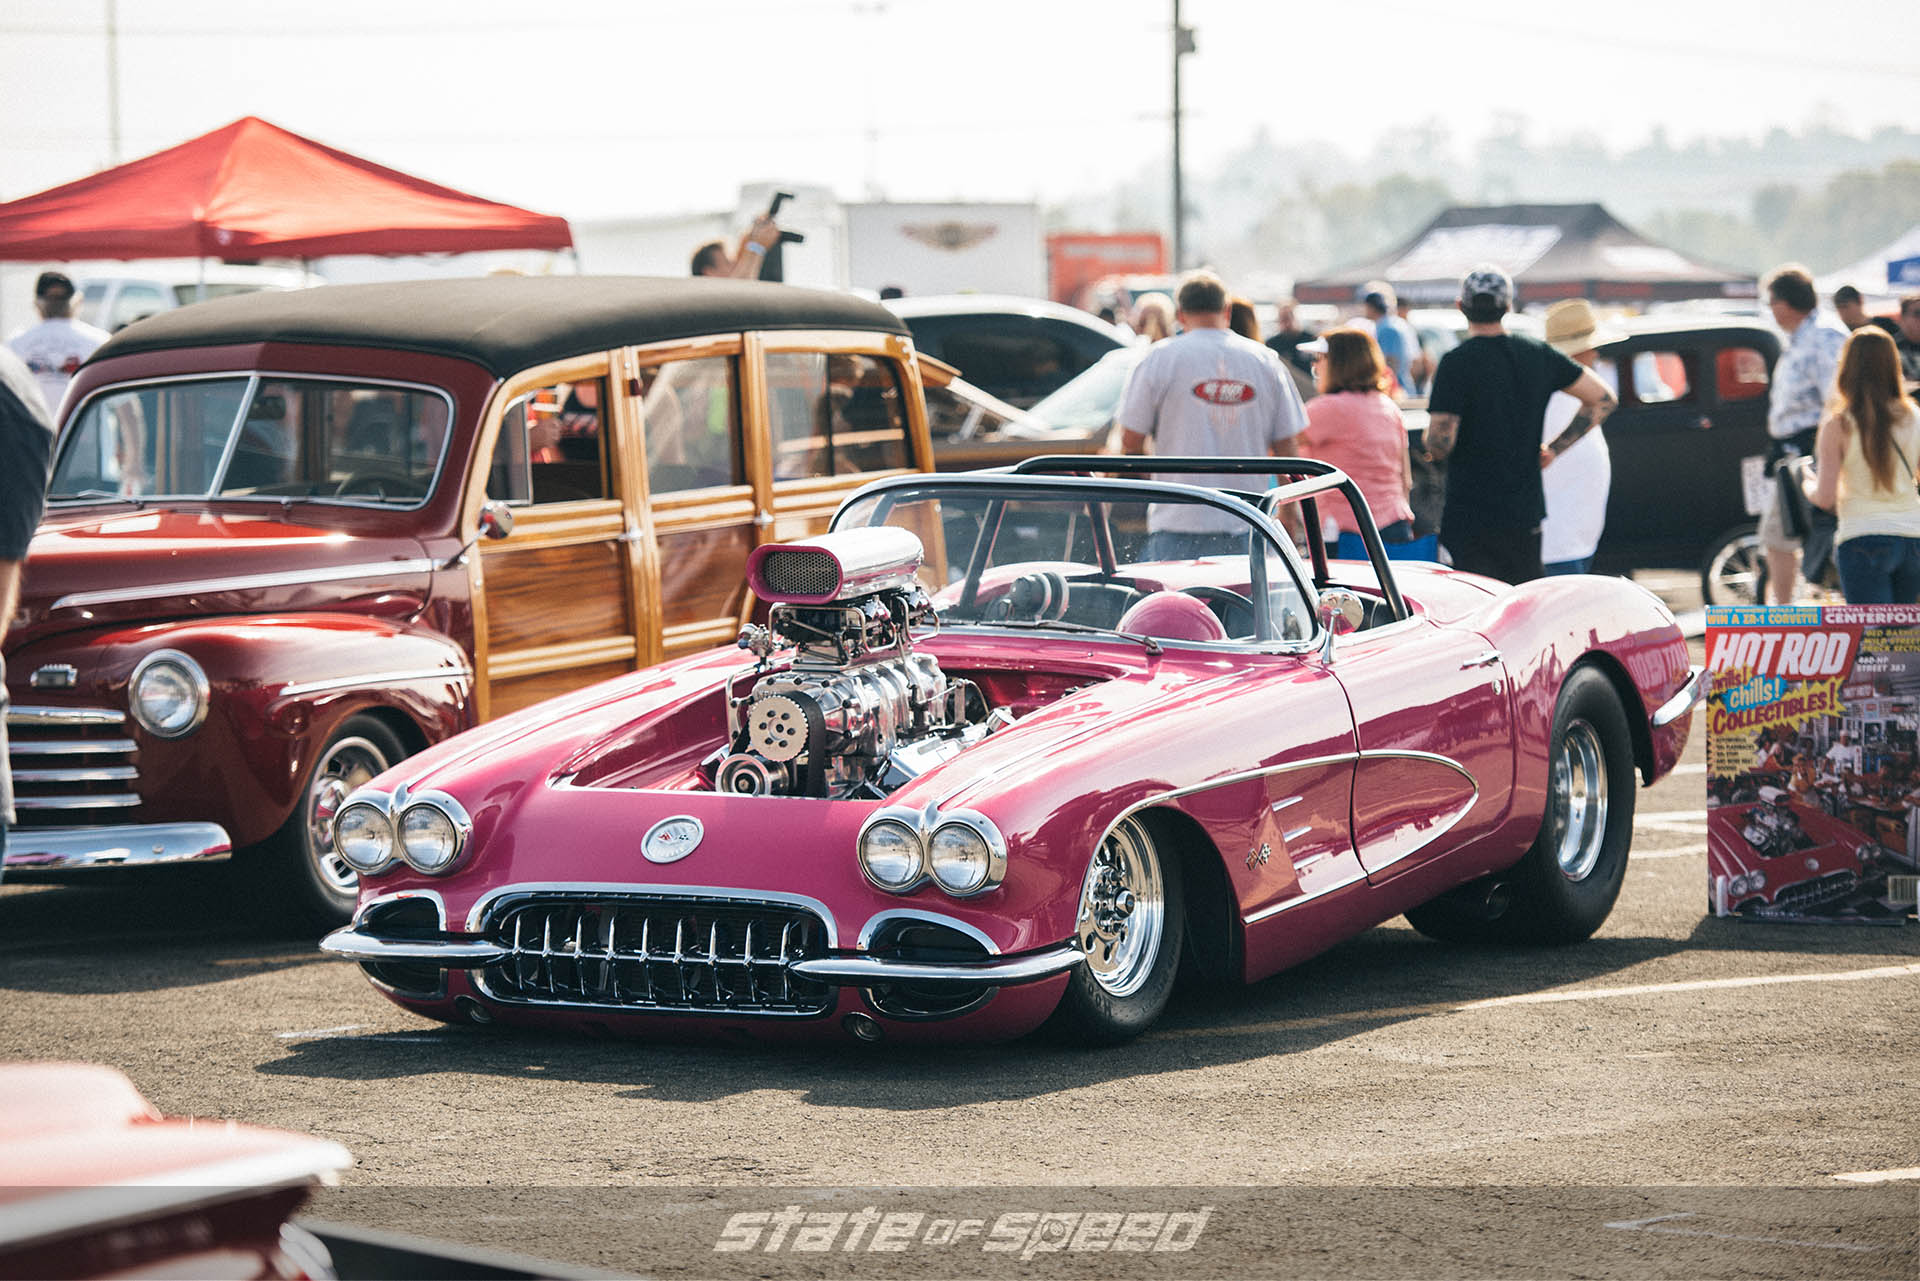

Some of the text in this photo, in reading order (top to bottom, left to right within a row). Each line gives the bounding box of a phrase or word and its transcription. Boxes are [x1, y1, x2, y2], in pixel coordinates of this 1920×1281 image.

[1707, 614, 1728, 624] WIN
[1731, 614, 1740, 624] A
[1768, 614, 1818, 624] CORVETTE
[1707, 632, 1851, 676] HOT ROD
[1713, 681, 1836, 735] COLLECTIBLES!
[1730, 677, 1780, 709] chills!
